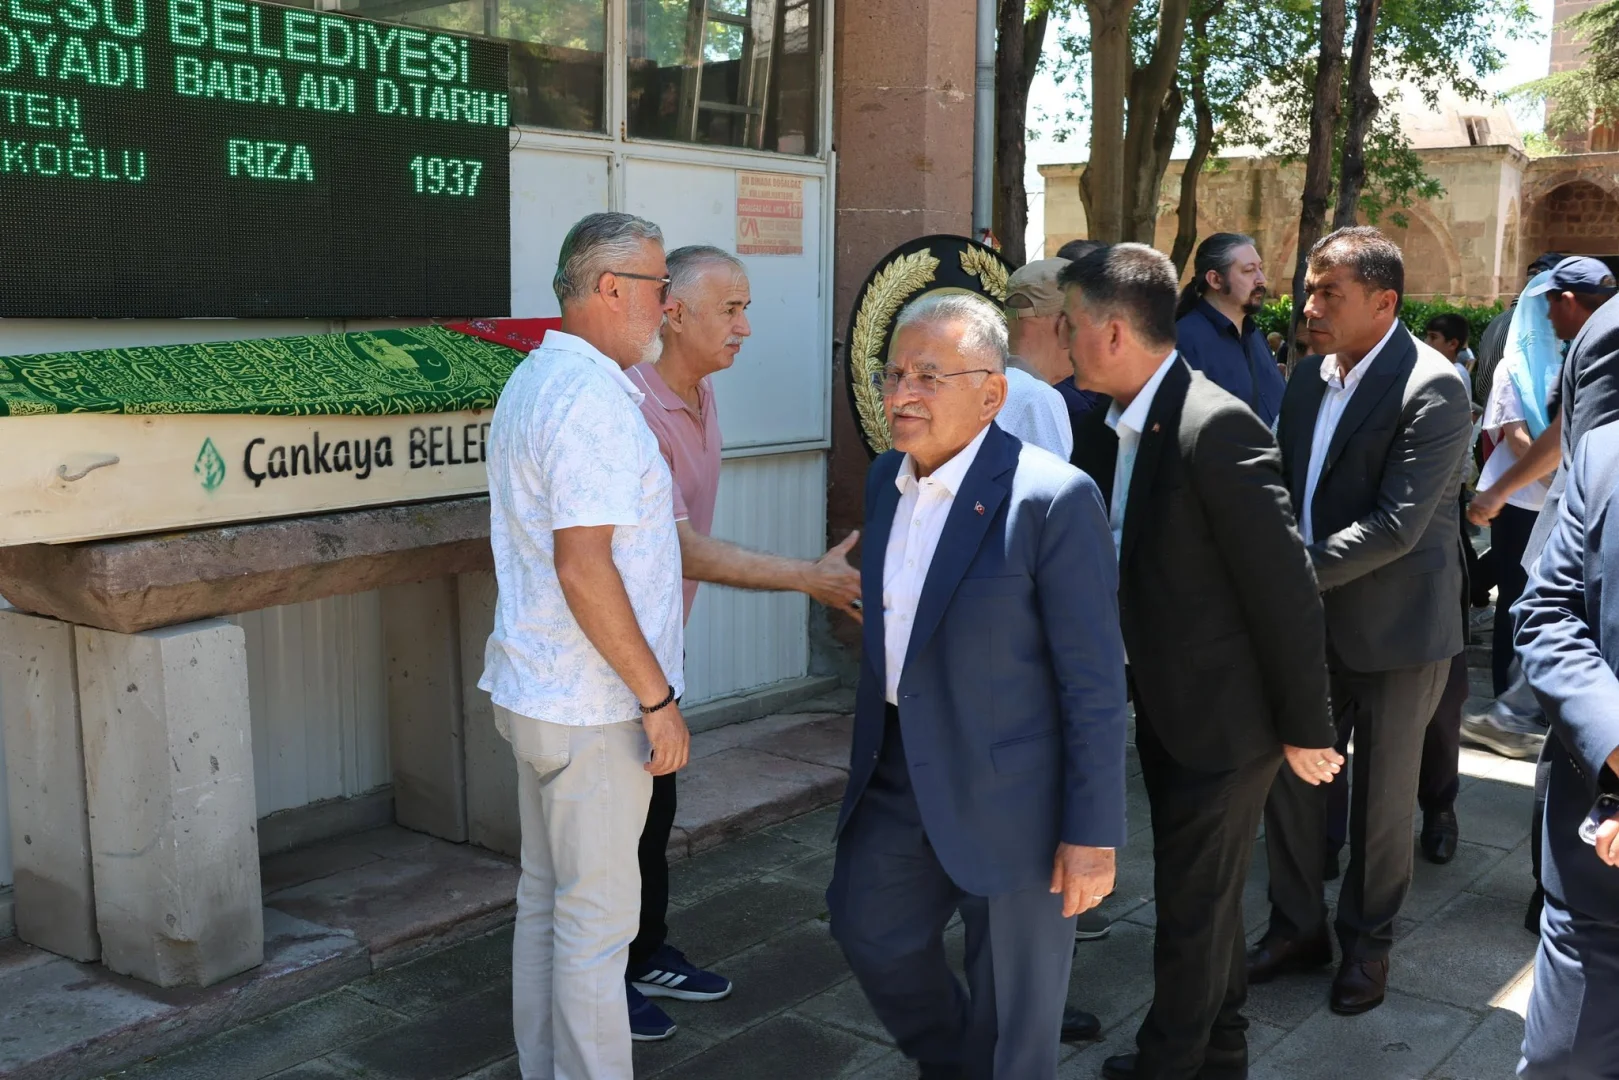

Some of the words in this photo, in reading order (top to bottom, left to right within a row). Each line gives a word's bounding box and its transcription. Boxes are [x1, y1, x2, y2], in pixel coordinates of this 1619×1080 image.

[0, 90, 79, 129] TEN
[176, 56, 286, 105] BABA
[298, 73, 355, 113] ADI
[4, 133, 145, 180] KOĞLU
[229, 139, 314, 181] RIZA
[411, 156, 483, 197] 1937
[244, 431, 394, 488] Çankaya
